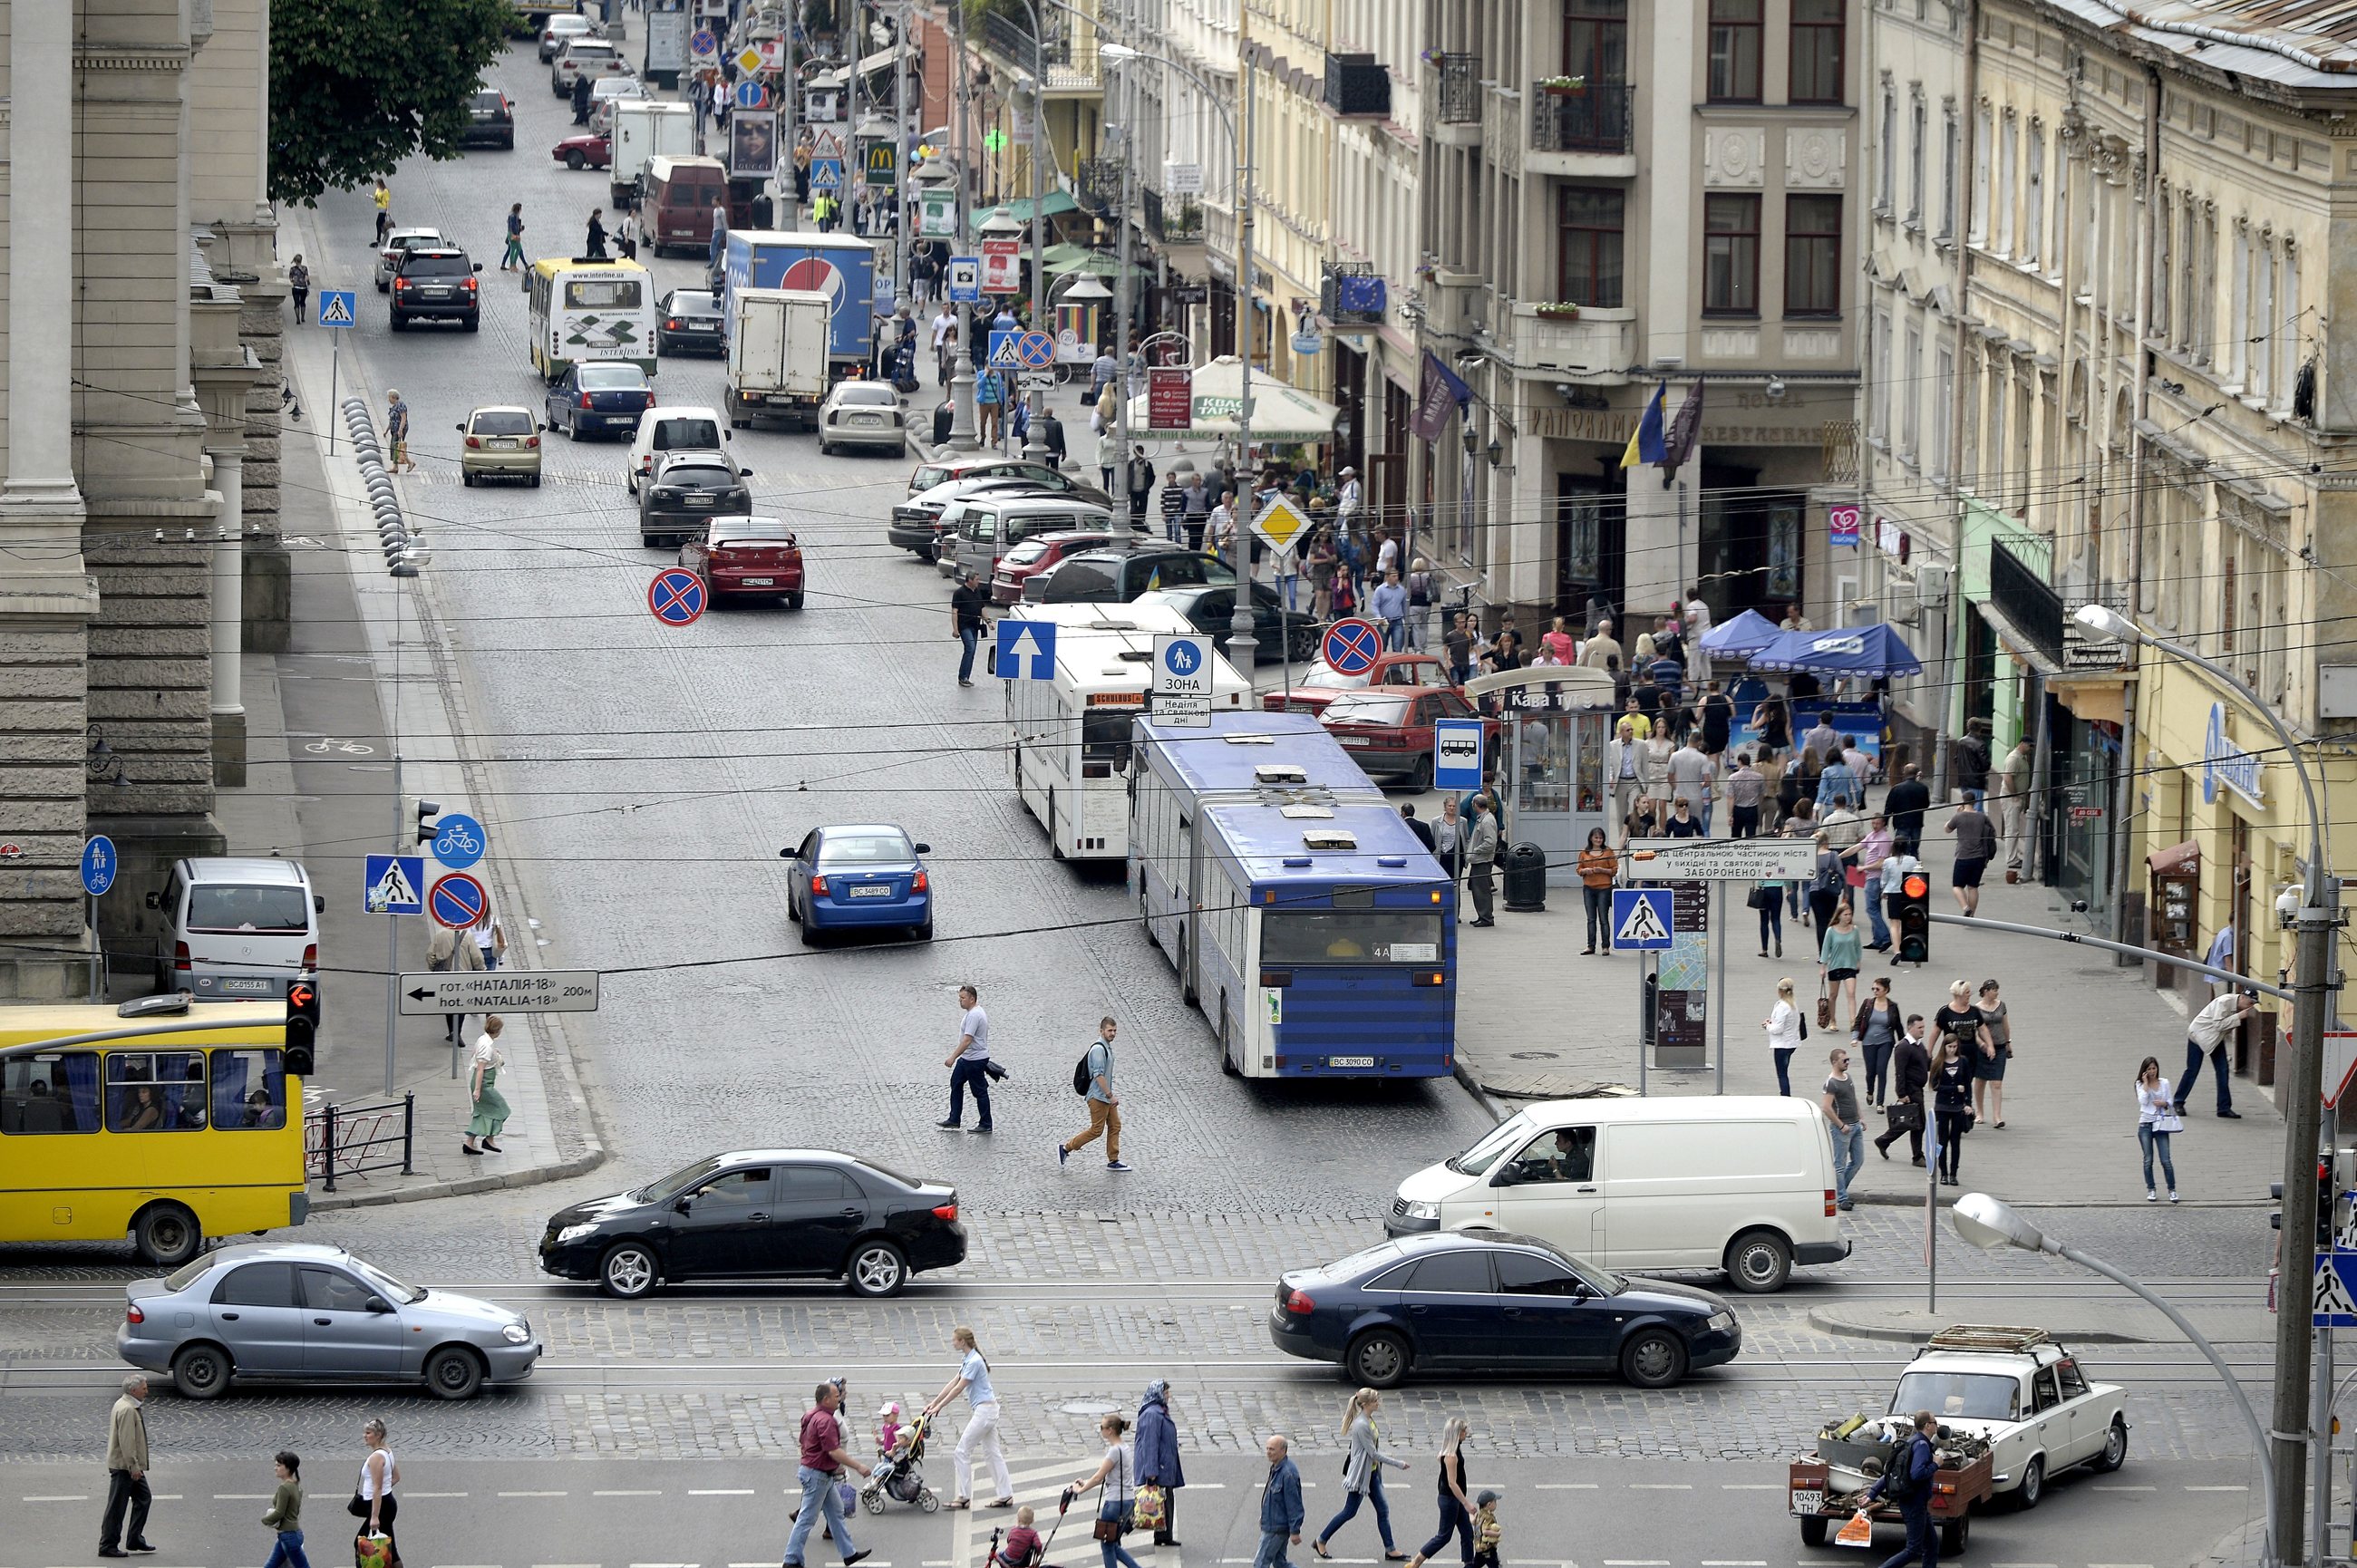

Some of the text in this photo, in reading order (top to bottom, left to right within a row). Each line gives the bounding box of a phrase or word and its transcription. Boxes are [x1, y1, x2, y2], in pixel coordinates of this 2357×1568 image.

[572, 271, 625, 279] www.interline.ua
[1198, 406, 1244, 415] ТАРА
[1165, 679, 1200, 691] ЗОНА
[1096, 694, 1132, 702] SCHULBUS
[1511, 691, 1549, 708] Кава
[1165, 700, 1198, 709] Неділя
[1174, 716, 1188, 724] дні
[1673, 850, 1733, 858] центральною
[1684, 868, 1761, 877] ЗАБОРОНЕНО!
[440, 982, 465, 992] гот.
[562, 986, 593, 997] 200м
[440, 996, 464, 1007] hot.
[1334, 1058, 1372, 1066] BC 3090 CO
[1794, 1492, 1821, 1502] 10493
[1800, 1505, 1814, 1514] TH
